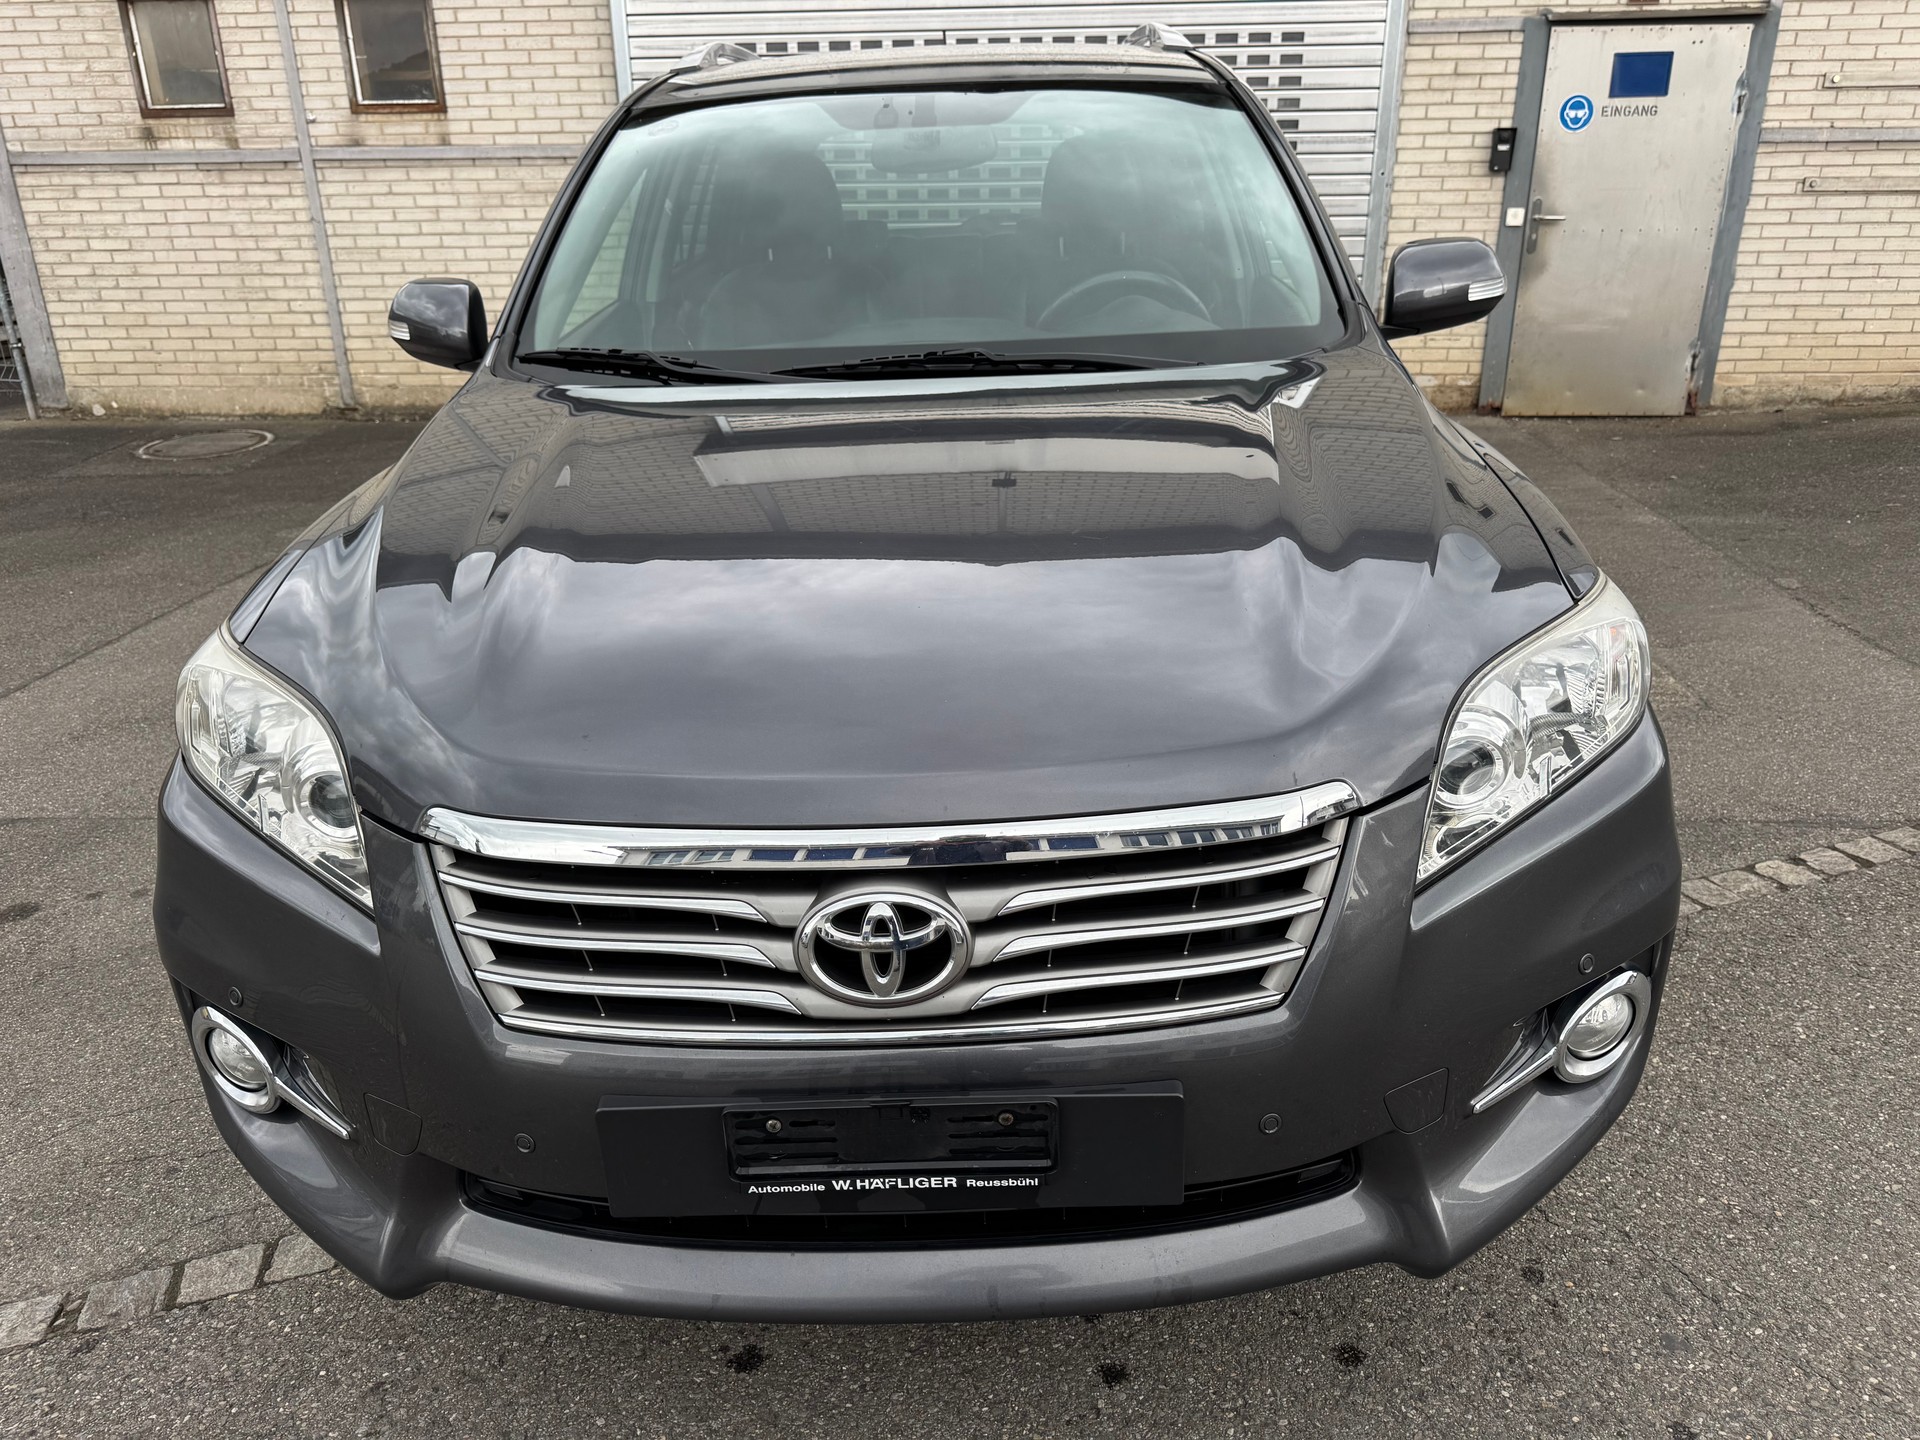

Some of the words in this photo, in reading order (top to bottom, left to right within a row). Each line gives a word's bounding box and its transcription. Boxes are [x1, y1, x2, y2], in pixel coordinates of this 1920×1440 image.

[1601, 105, 1658, 117] EINGANG
[748, 1183, 825, 1193] Automobile
[966, 1177, 1039, 1187] Reussbühl
